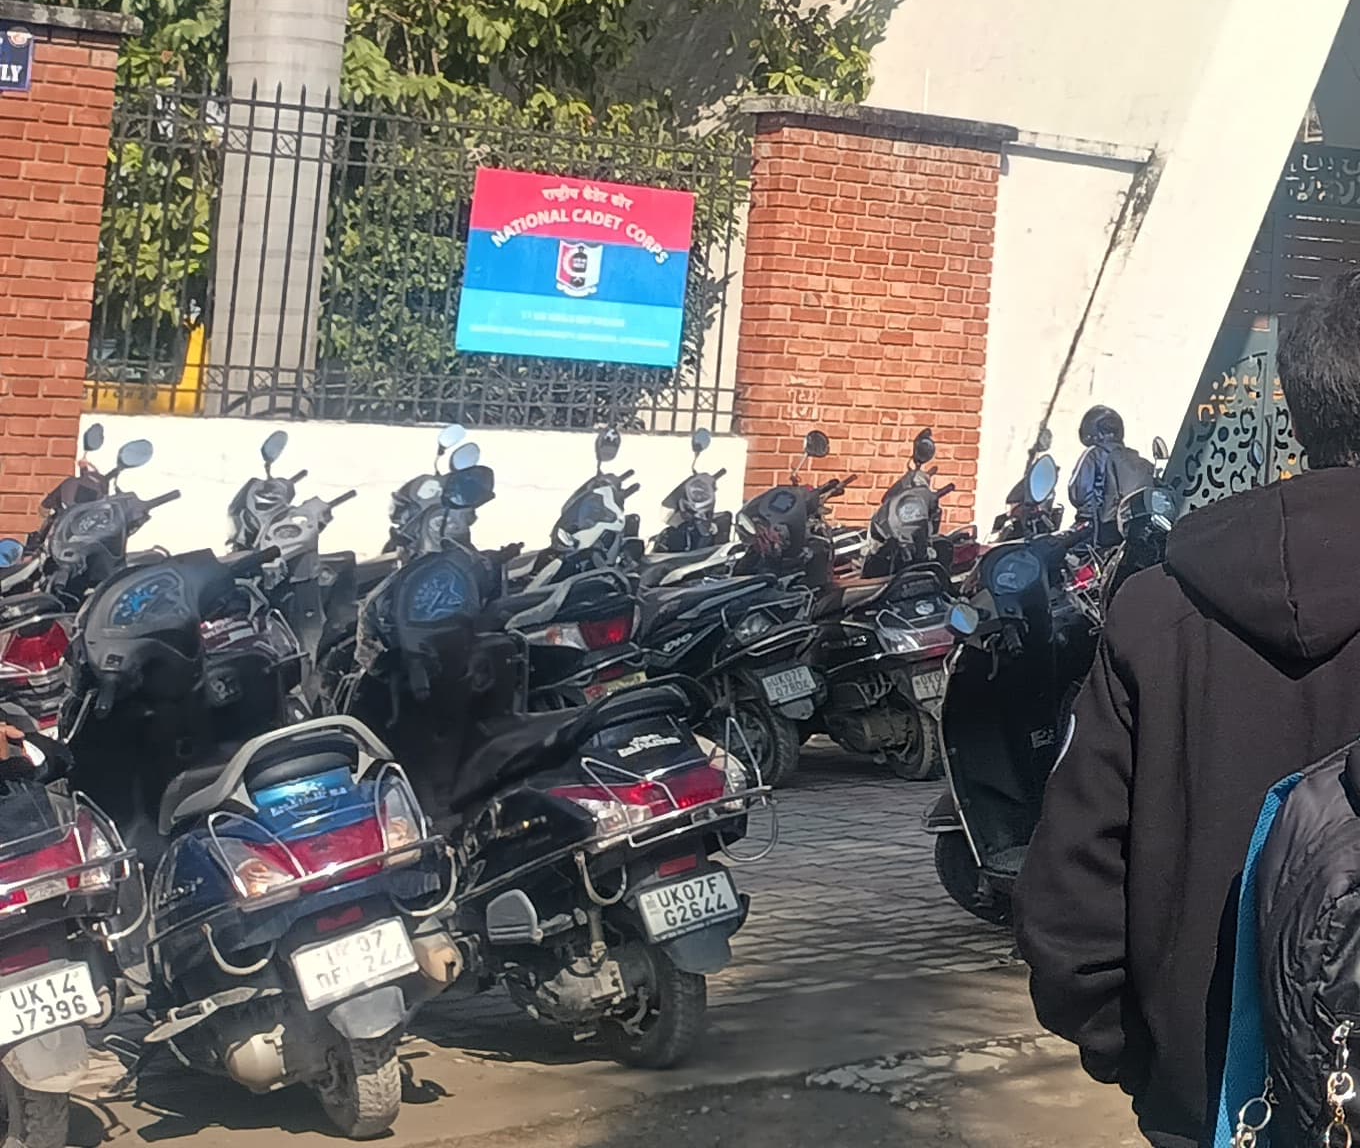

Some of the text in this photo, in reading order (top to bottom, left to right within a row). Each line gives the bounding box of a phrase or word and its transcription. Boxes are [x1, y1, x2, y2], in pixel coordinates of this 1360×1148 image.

[490, 208, 670, 265] NATIONAL CADET CORPS
[656, 876, 718, 909] UK07F
[663, 894, 729, 927] G2644
[11, 994, 88, 1036] J7396
